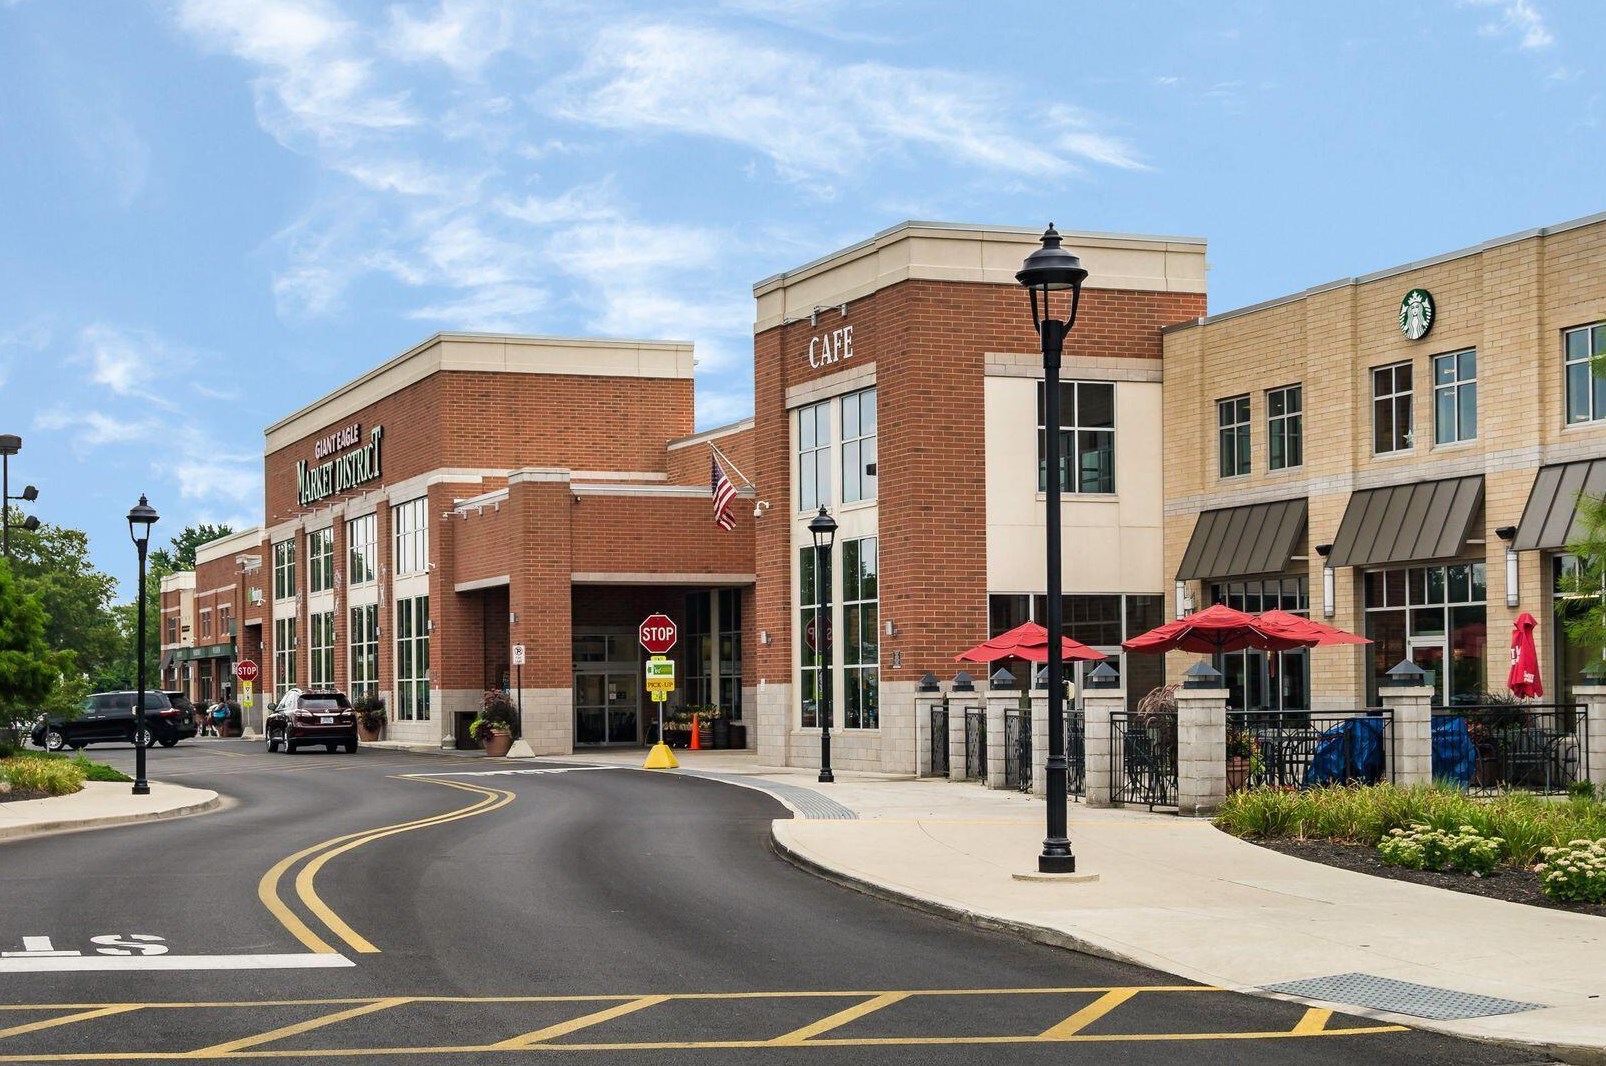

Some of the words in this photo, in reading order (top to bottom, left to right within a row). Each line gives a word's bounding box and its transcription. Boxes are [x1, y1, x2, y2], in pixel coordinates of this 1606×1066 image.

[809, 325, 853, 369] CAFE
[315, 434, 336, 459] GIANT
[337, 424, 359, 449] EAGLE
[297, 460, 333, 505] MARKET
[336, 426, 381, 490] DISTRICT
[642, 626, 674, 642] STOP
[238, 667, 257, 675] STOP
